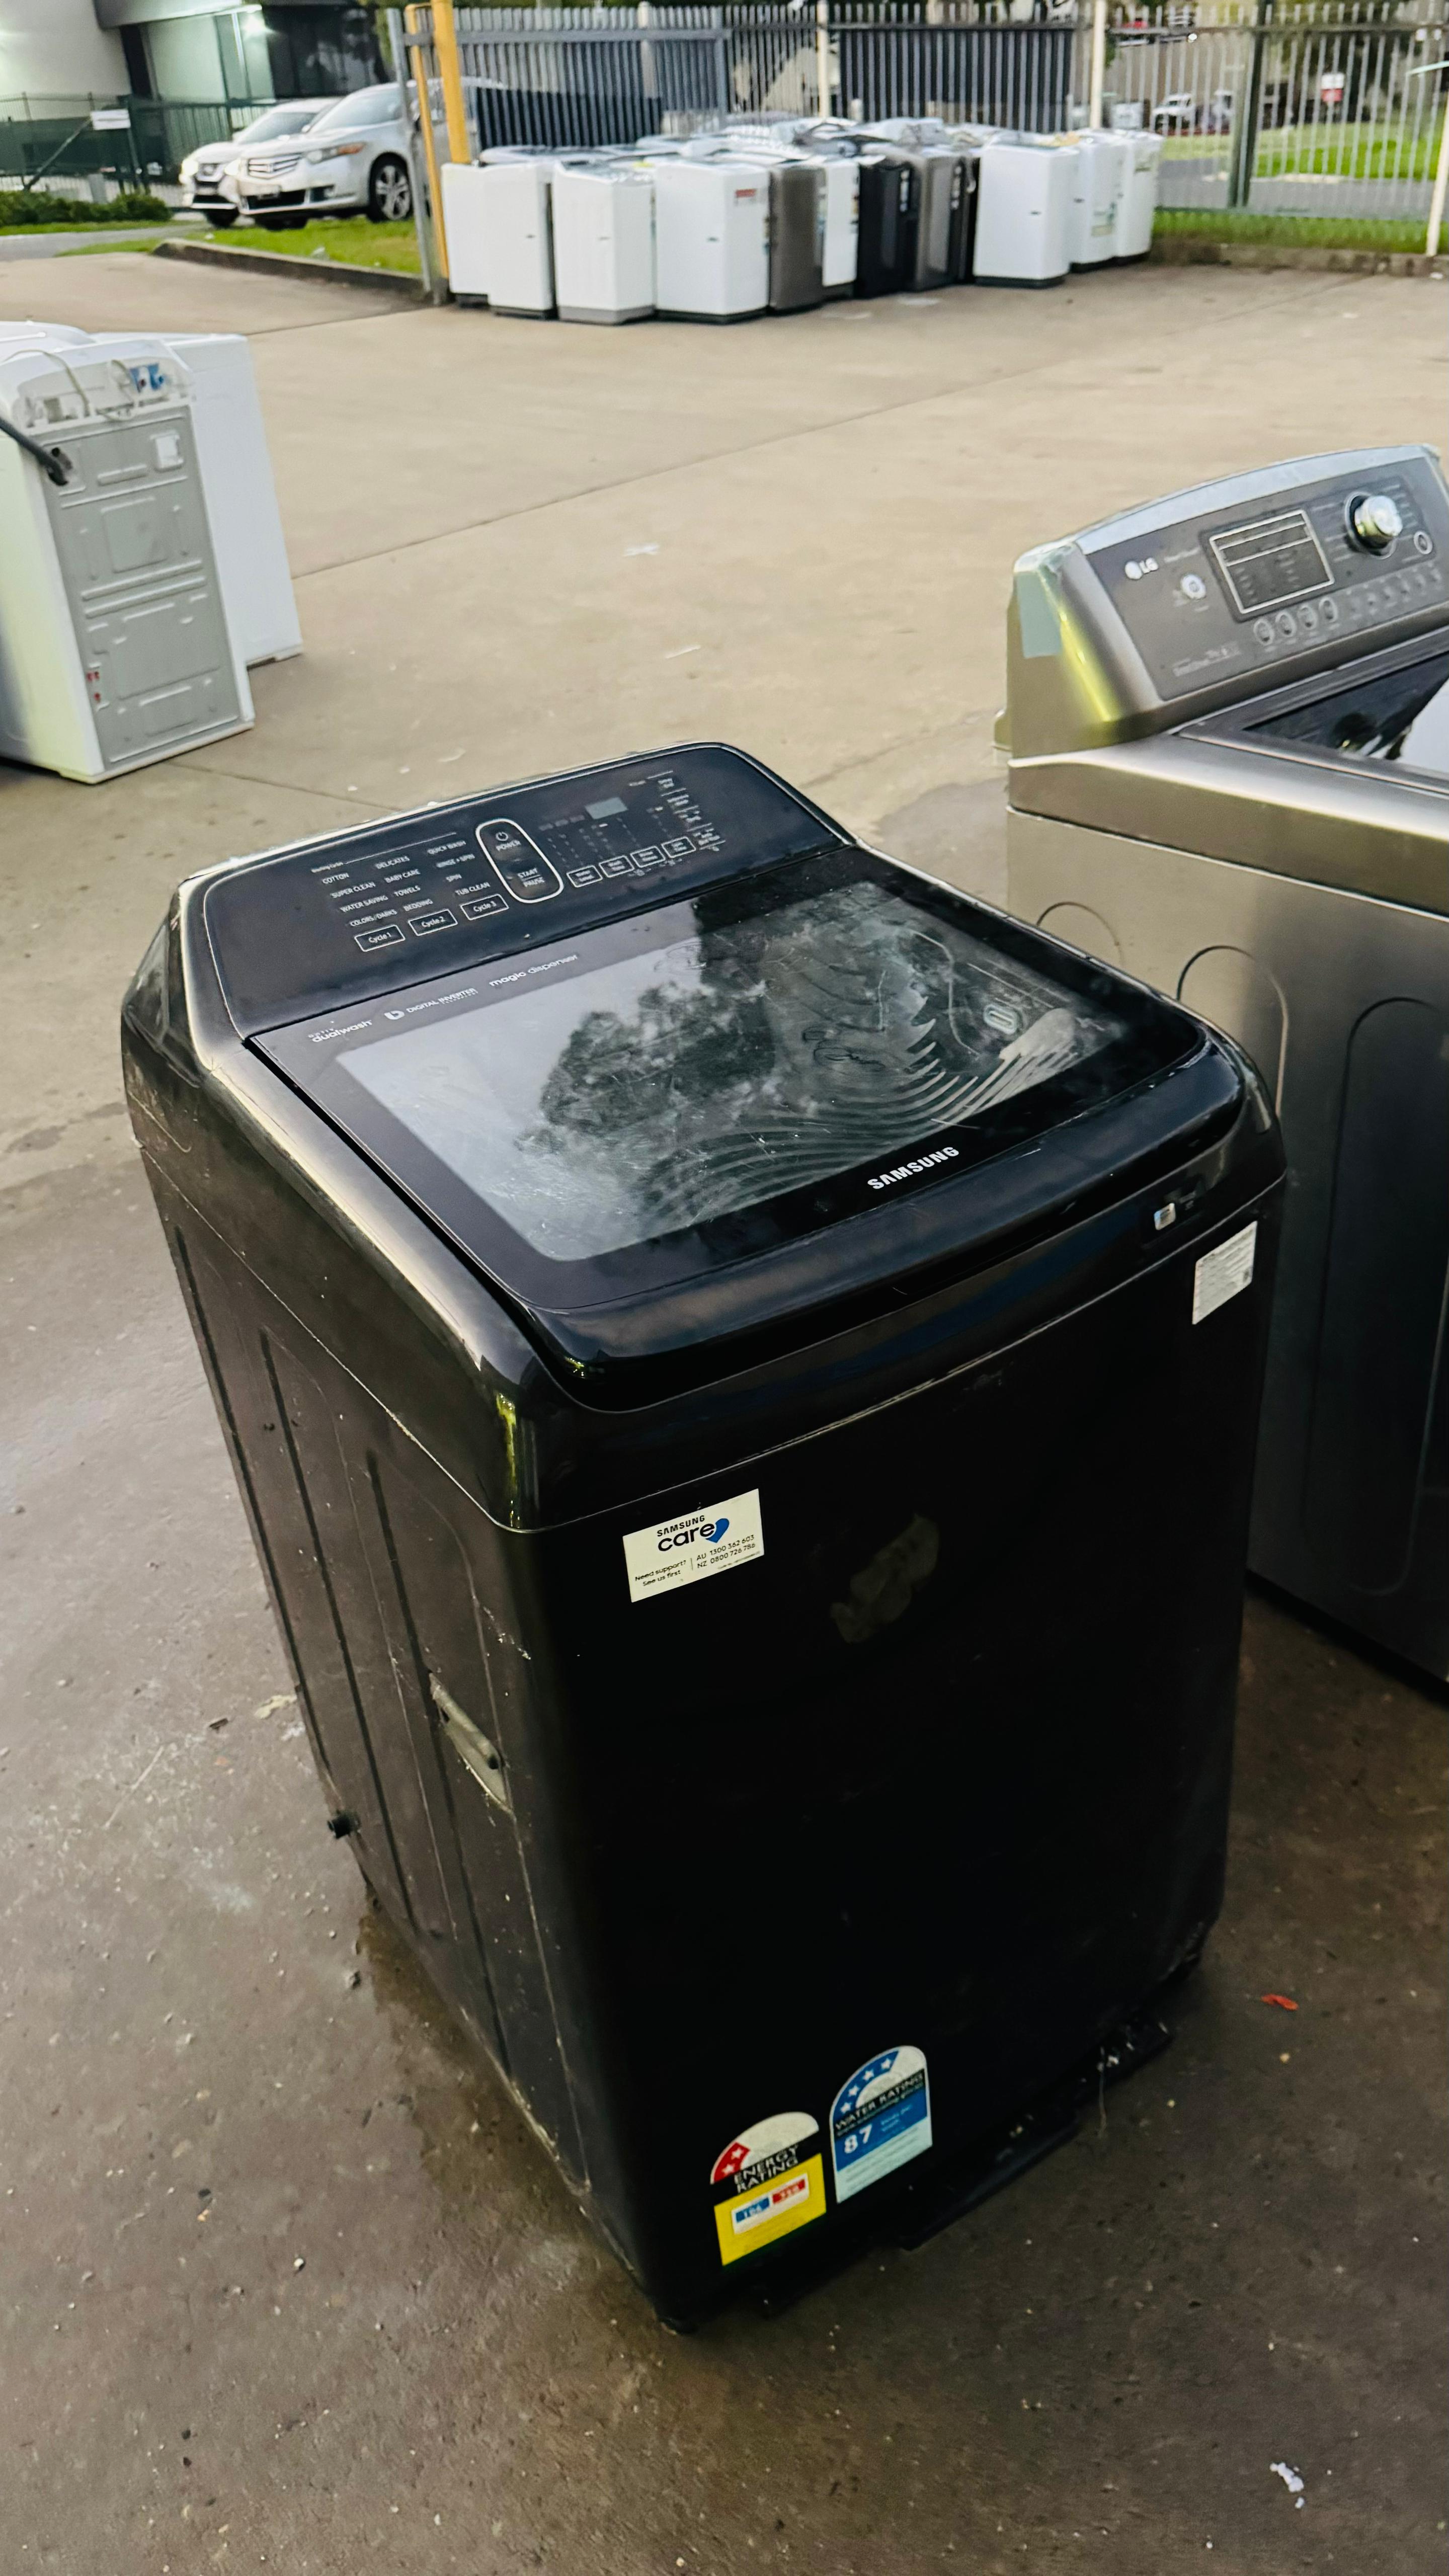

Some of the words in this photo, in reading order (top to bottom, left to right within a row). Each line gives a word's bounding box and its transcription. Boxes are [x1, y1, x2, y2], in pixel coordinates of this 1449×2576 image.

[496, 840, 521, 851] POWER
[375, 856, 410, 869] DELICATES
[322, 872, 350, 884] COTTON
[384, 874, 402, 883] BABY
[403, 869, 421, 878] CARE
[446, 873, 462, 881] SPIN
[518, 867, 538, 878] START
[455, 887, 469, 896] TUB
[469, 881, 491, 892] CLEAN
[523, 877, 545, 887] PAUSE
[330, 888, 354, 898] SUPER
[353, 882, 376, 893] CLEAN
[394, 886, 421, 897] TOWELS
[340, 902, 364, 913] WATER
[364, 895, 388, 906] SAVING
[403, 899, 433, 911] BEDDING
[473, 903, 491, 913] Cycle
[421, 917, 440, 928] Cycle
[368, 934, 388, 944] Cycle
[489, 970, 526, 987] magic
[527, 954, 579, 974] dispenser
[406, 998, 439, 1013] DIGITAL
[311, 1019, 372, 1043] dualwash
[867, 1147, 959, 1189] SAMSUNG
[657, 1515, 705, 1537] SAMSUNG
[658, 1523, 715, 1551] care
[710, 1546, 726, 1556] 1300
[728, 1540, 740, 1549] 362
[741, 1535, 755, 1544] 603
[697, 1561, 707, 1569] NZ
[710, 1553, 729, 1564] 0800
[729, 1548, 742, 1557] 726
[635, 1571, 654, 1581] Need
[655, 1560, 687, 1574] support?
[667, 1570, 681, 1578] first
[836, 2102, 876, 2130] WATER
[879, 2073, 923, 2112] RATING
[844, 2124, 872, 2153] 87
[734, 2144, 799, 2184] ENERGY
[737, 2159, 799, 2193] RATING
